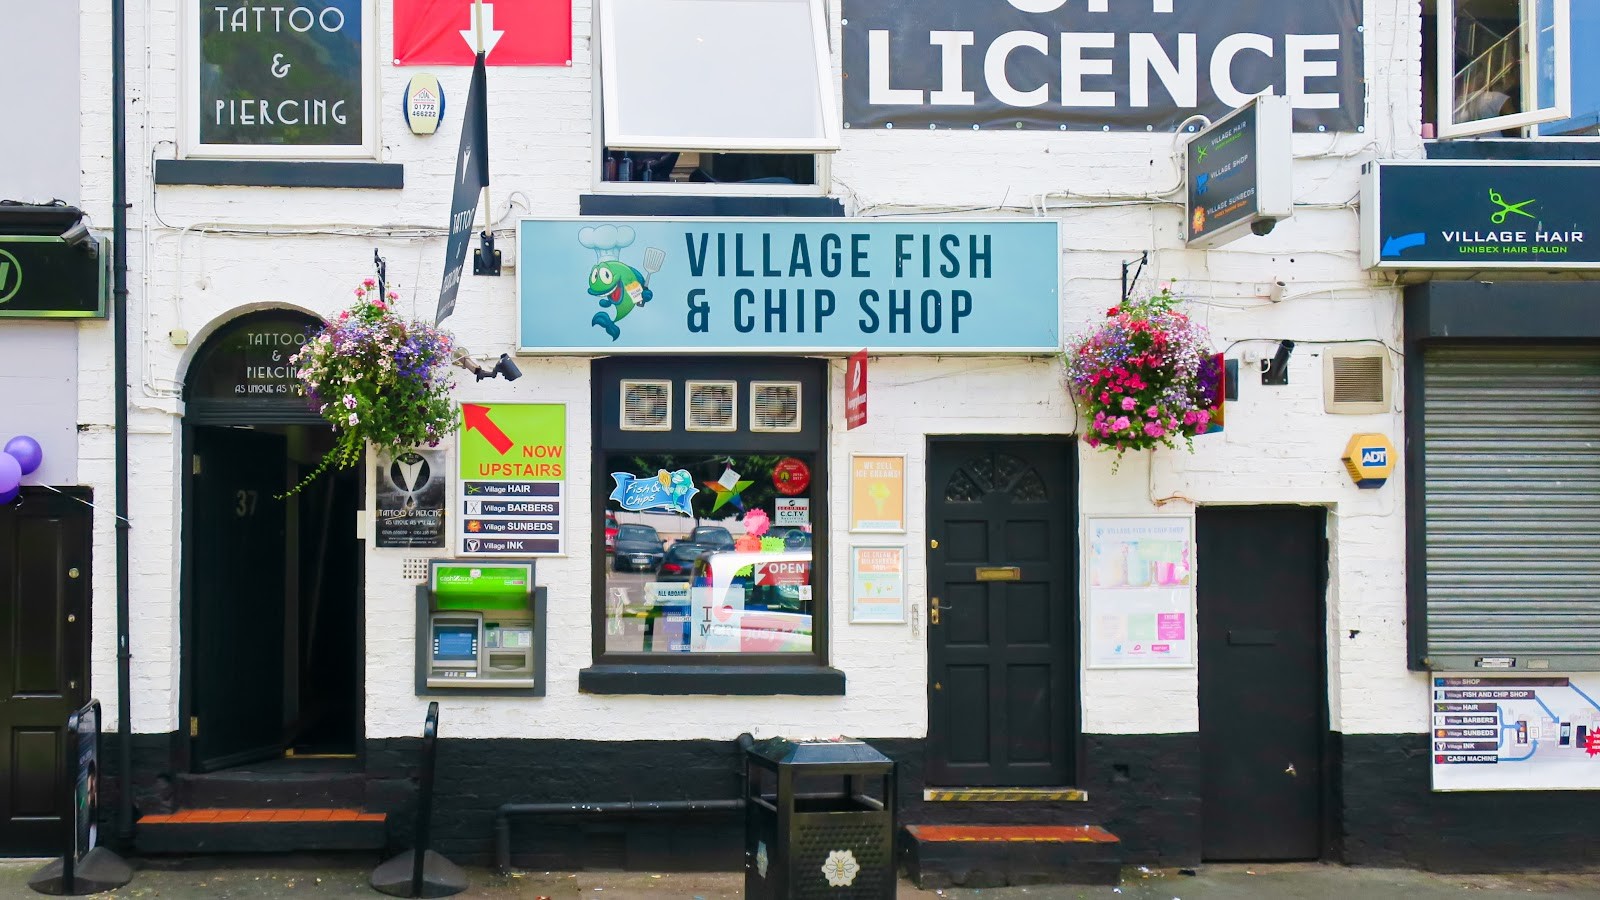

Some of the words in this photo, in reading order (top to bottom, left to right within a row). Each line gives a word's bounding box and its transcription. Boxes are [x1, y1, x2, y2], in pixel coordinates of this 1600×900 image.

[215, 7, 344, 32] TATTOO
[270, 53, 290, 78] &
[868, 30, 1340, 109] LICENCE
[216, 100, 346, 125] PIERCING
[1211, 129, 1232, 146] VILLAGE
[1233, 121, 1247, 134] HAIR
[1210, 163, 1231, 178] VILLAGE
[1232, 154, 1248, 168] SHOP
[1207, 200, 1228, 214] VILLAGE
[1229, 188, 1255, 204] SUNBEDS
[1442, 231, 1527, 242] VILLAGE
[1536, 231, 1584, 242] HAIR
[686, 232, 872, 278] VILLAGE
[894, 234, 993, 278] FISH
[686, 288, 710, 332] &
[733, 288, 836, 333] CHIP
[858, 288, 973, 334] SHOP
[248, 334, 306, 345] TATTOO
[272, 350, 281, 361] &
[247, 367, 297, 378] PIERCIN
[235, 385, 245, 393] AS
[248, 385, 273, 393] UNIQUE
[276, 385, 286, 393] AS
[523, 446, 562, 458] NOW
[1362, 450, 1386, 462] ADT
[480, 464, 562, 476] UPSTAIRS
[484, 486, 506, 494] Village
[651, 482, 660, 493] &
[236, 490, 257, 516] 37
[626, 494, 656, 506] Chips
[484, 505, 506, 513] Village
[508, 504, 554, 512] BARBERS
[484, 524, 506, 532] Village
[508, 523, 553, 531] SUNBEDS
[507, 541, 523, 549] INK
[769, 563, 805, 574] OPEN
[702, 606, 712, 622] I
